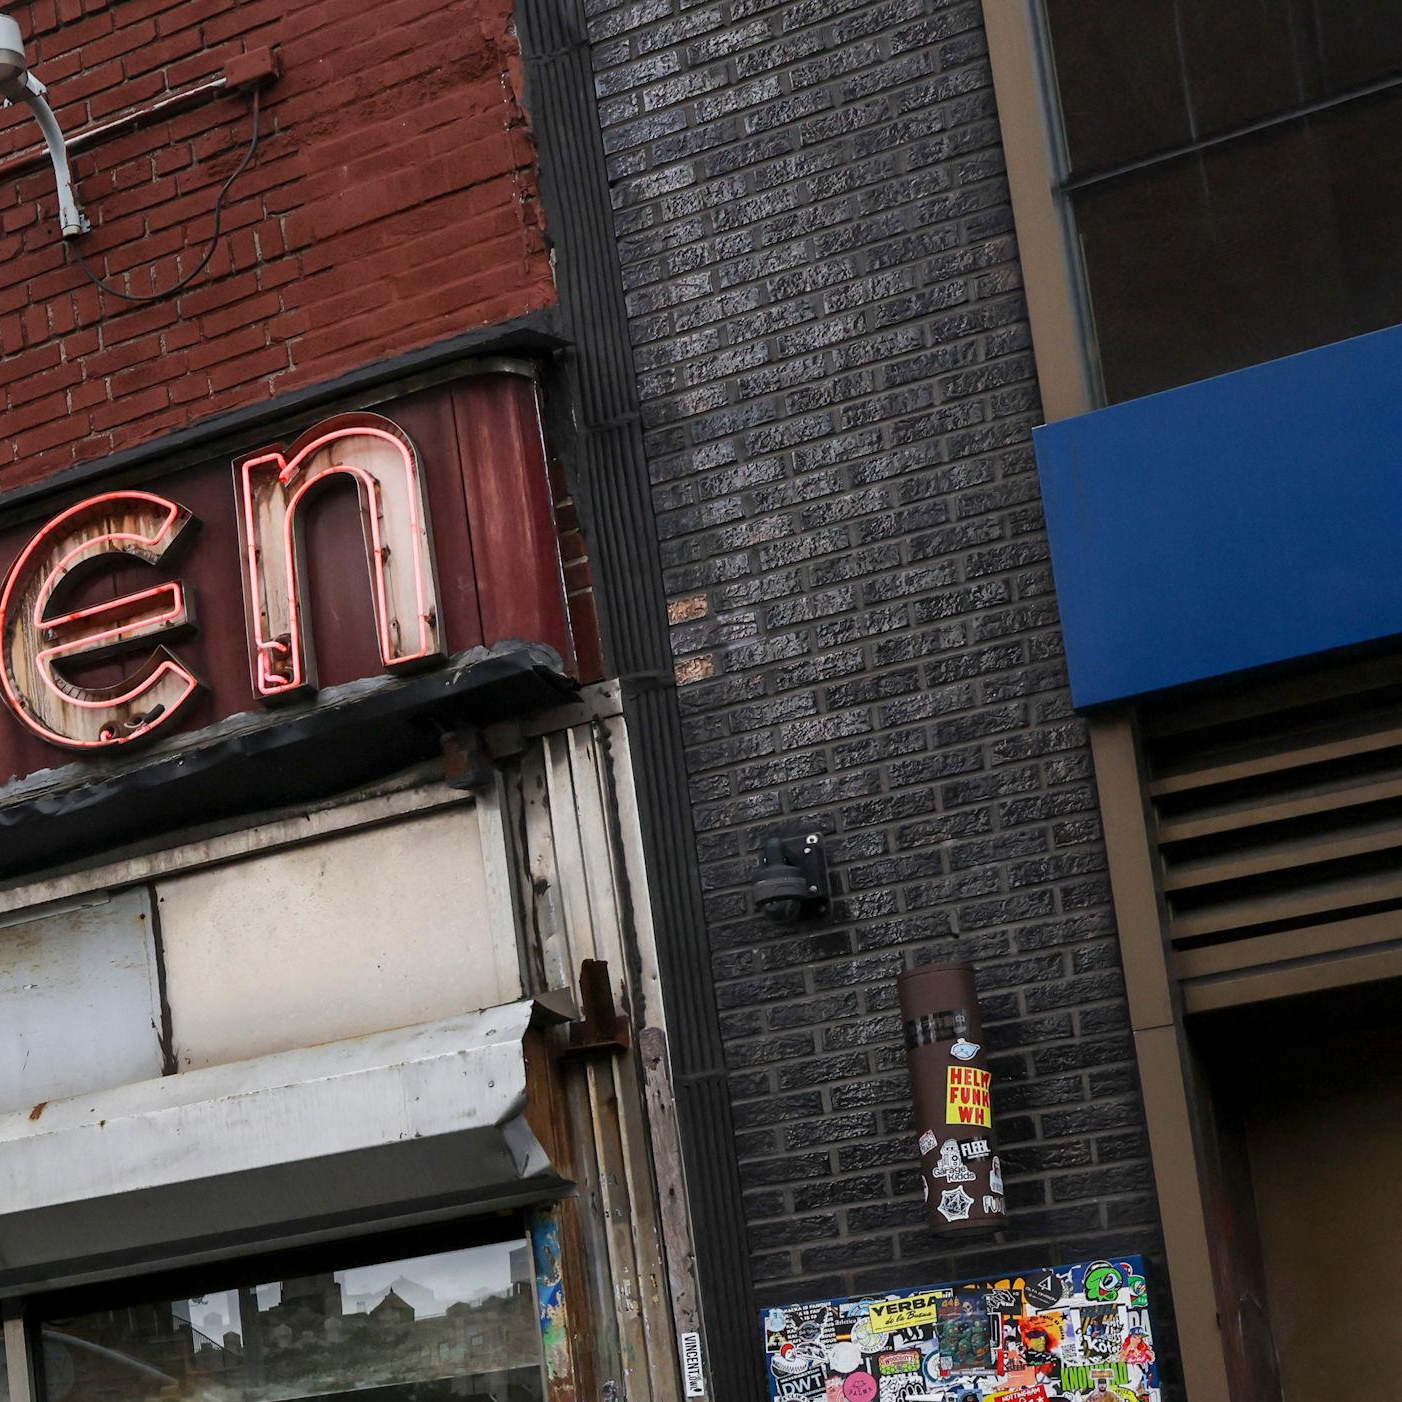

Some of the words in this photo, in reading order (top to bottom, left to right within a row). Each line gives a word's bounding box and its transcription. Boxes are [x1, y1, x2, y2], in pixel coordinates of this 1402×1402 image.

[932, 1165, 967, 1177] Garage
[947, 1171, 976, 1182] Kidds
[871, 1295, 937, 1317] YERBA
[684, 1335, 700, 1374] VINCENT
[781, 1372, 823, 1397] DWT
[1001, 1386, 1041, 1402] NOTTINGHAM
